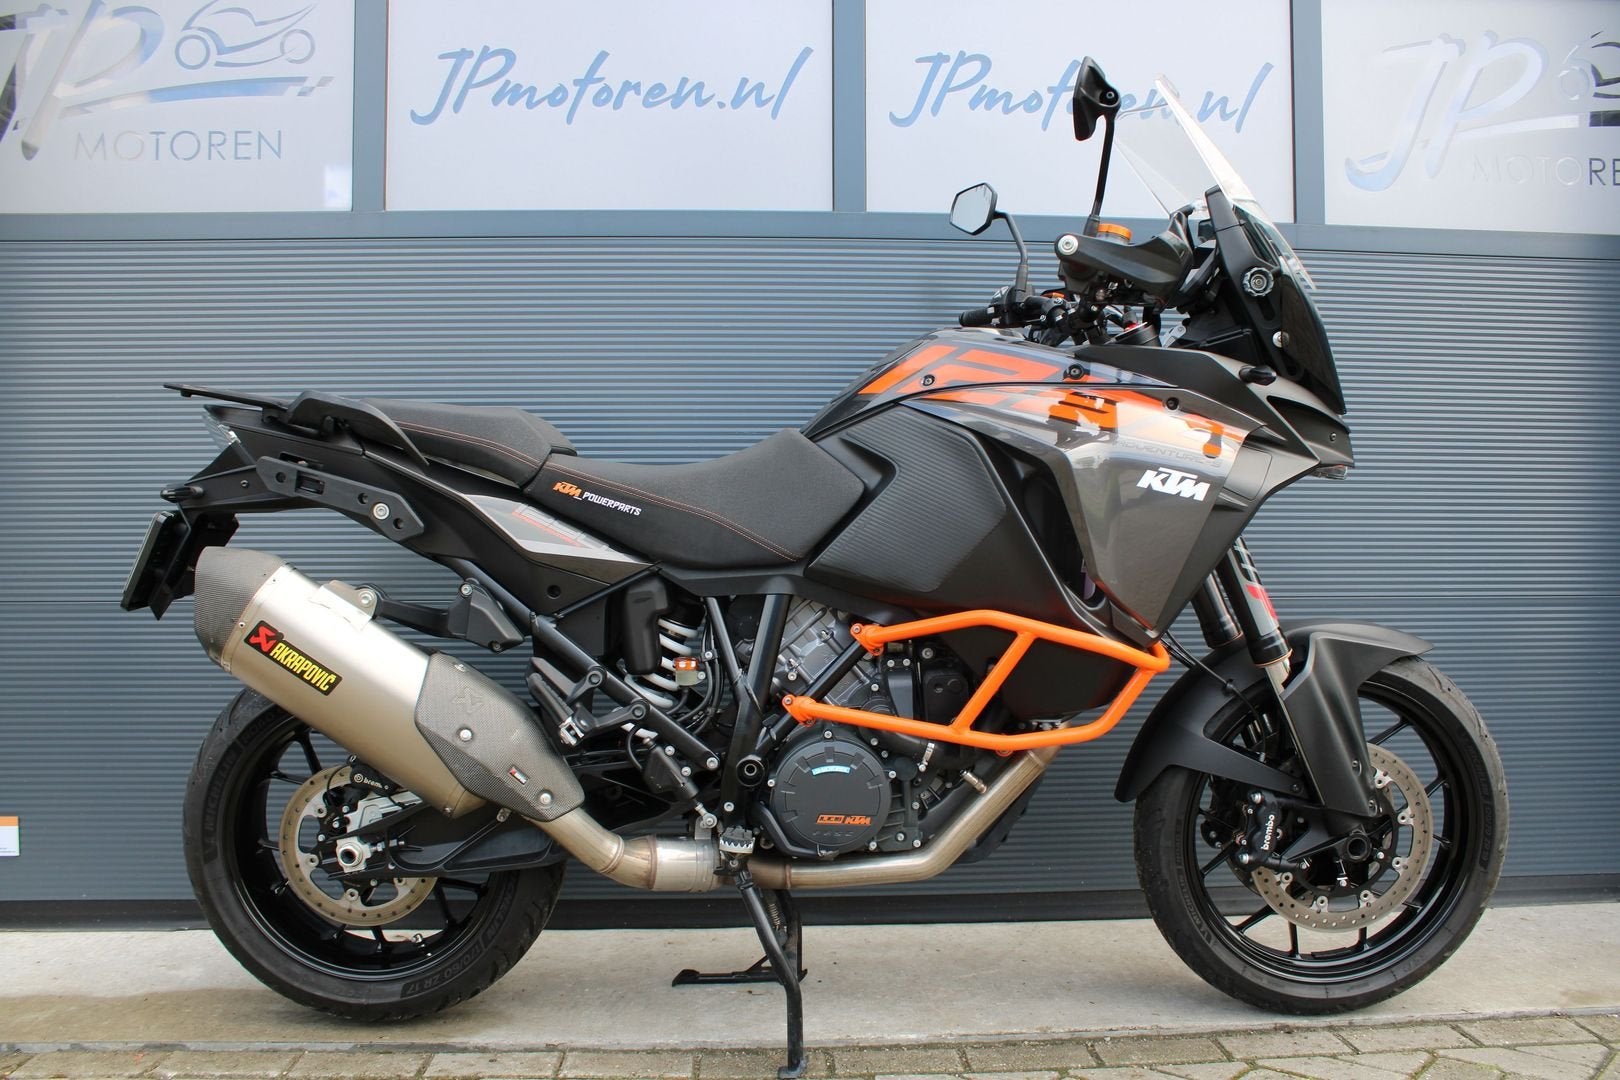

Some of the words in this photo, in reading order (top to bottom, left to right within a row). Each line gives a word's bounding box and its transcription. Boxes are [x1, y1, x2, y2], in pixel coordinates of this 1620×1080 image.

[410, 45, 814, 125] JPmotoren.nl
[74, 130, 282, 161] MOTOREN
[552, 481, 582, 497] KTM
[582, 491, 642, 516] POWERPARTS
[1136, 467, 1211, 502] KTM
[1260, 814, 1276, 851] brembo
